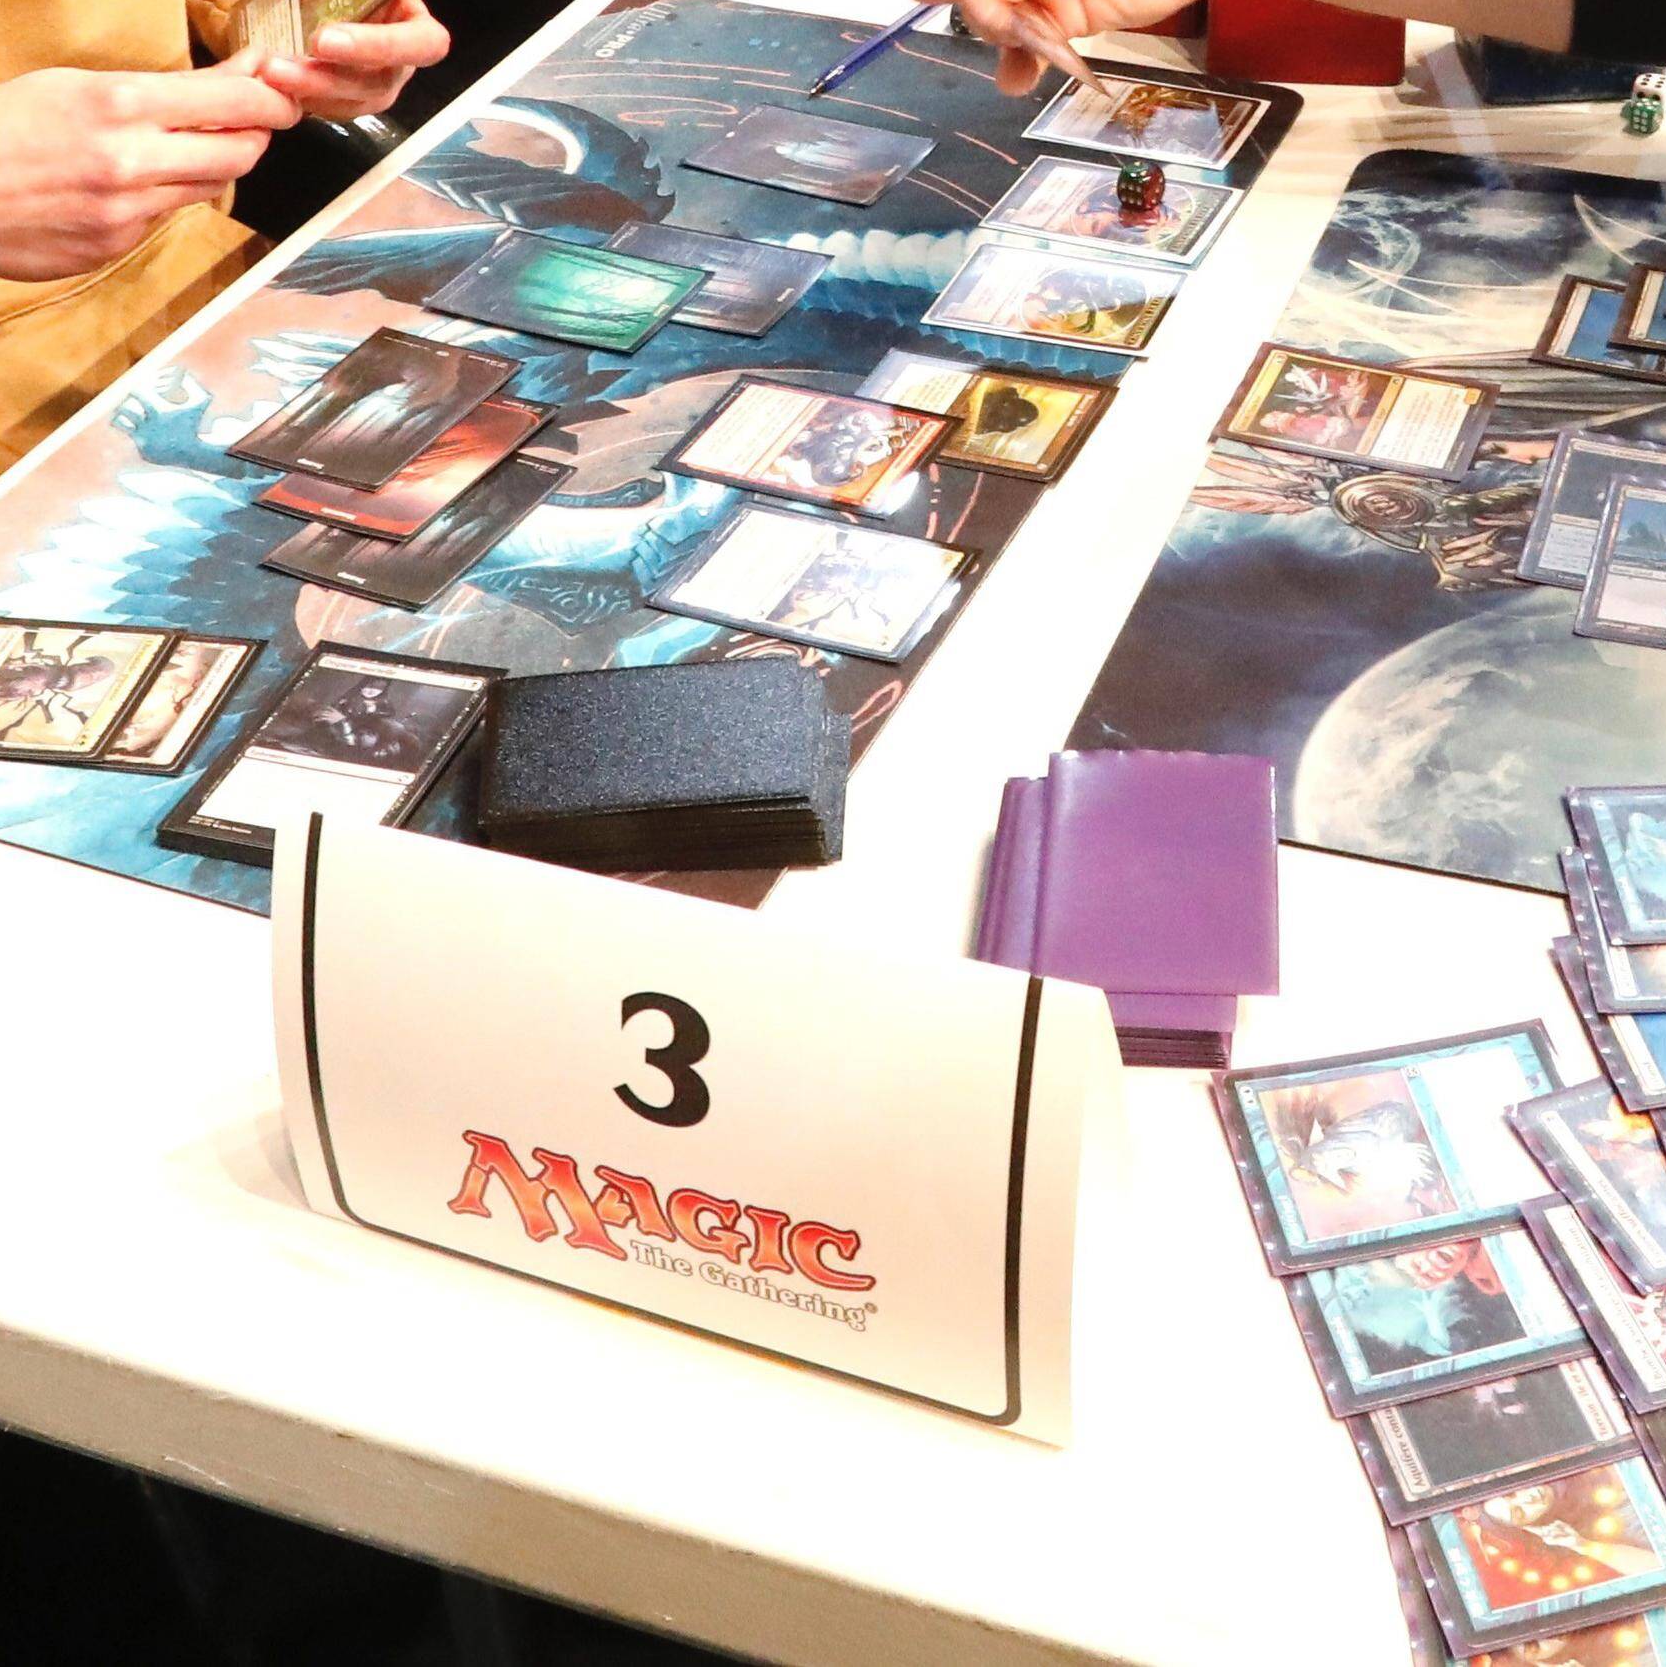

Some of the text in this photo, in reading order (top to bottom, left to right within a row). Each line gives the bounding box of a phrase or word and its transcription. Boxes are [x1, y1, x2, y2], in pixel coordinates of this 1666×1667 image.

[612, 991, 712, 1128] 3
[446, 1128, 878, 1292] MAGIC
[629, 1239, 869, 1333] The Gathering
[1381, 1406, 1428, 1489] Aquifère conta
